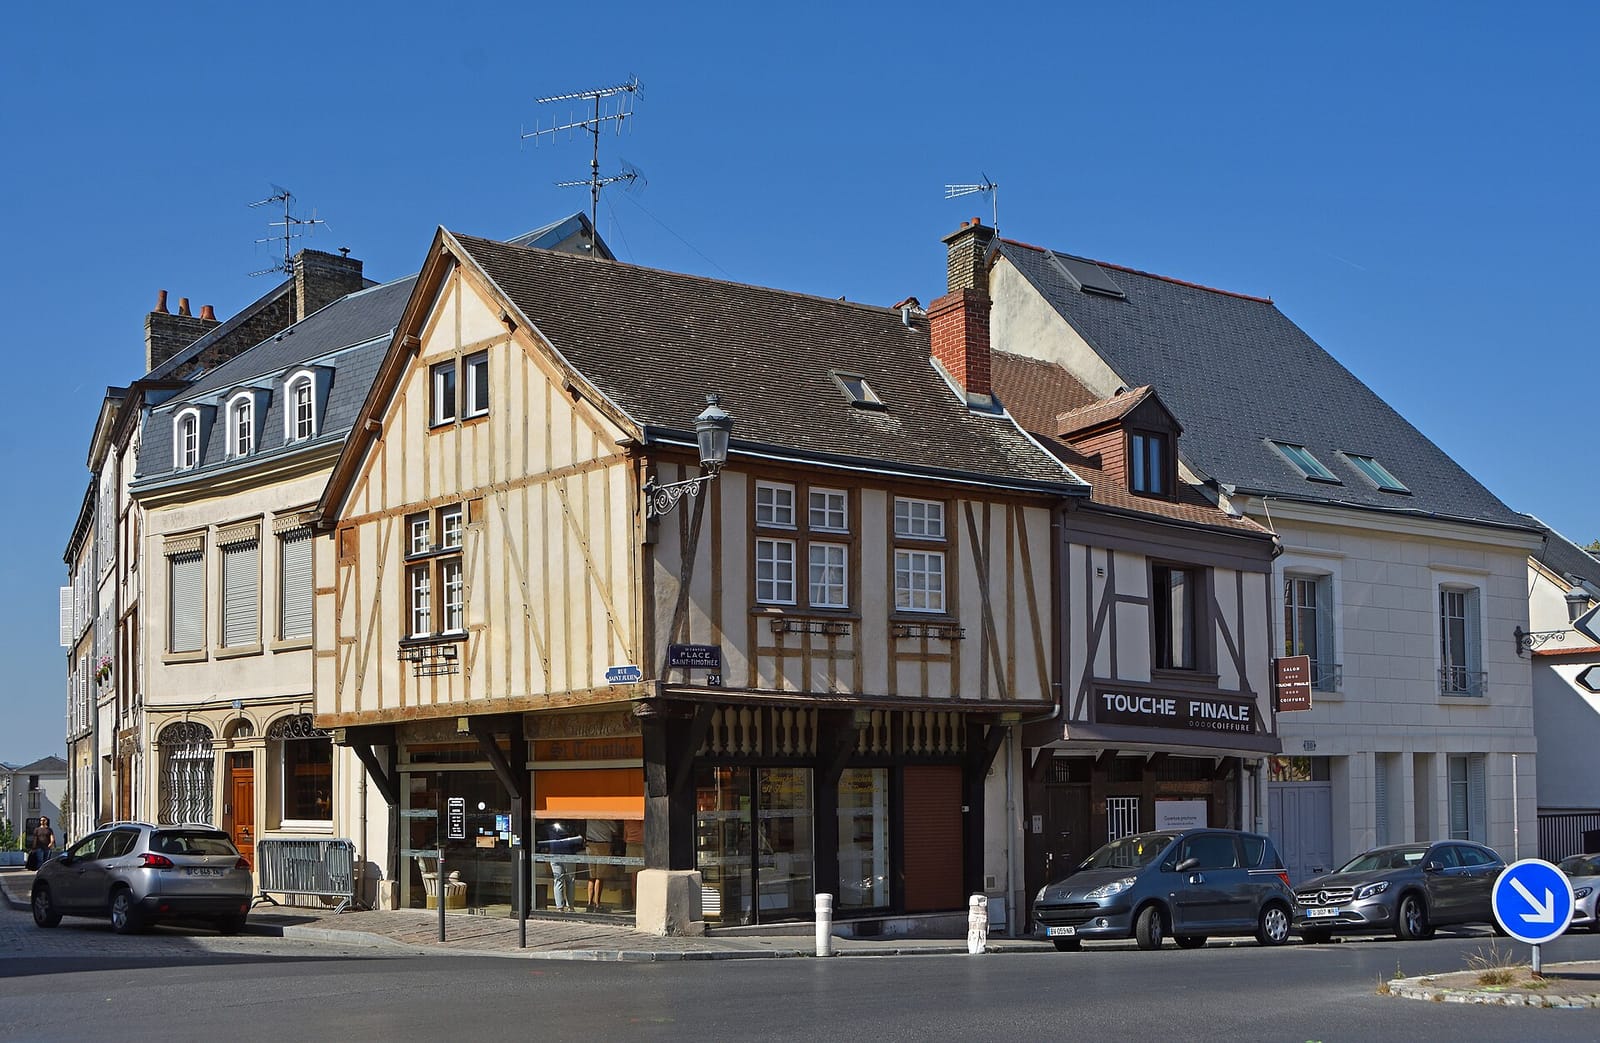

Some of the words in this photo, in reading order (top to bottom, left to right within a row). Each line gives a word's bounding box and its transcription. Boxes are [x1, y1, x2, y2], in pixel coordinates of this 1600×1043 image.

[680, 651, 711, 659] PLACE
[709, 675, 720, 685] 24
[1102, 693, 1177, 716] TOUCHE
[1188, 700, 1250, 722] FINALE
[1211, 721, 1250, 732] COIFFURE
